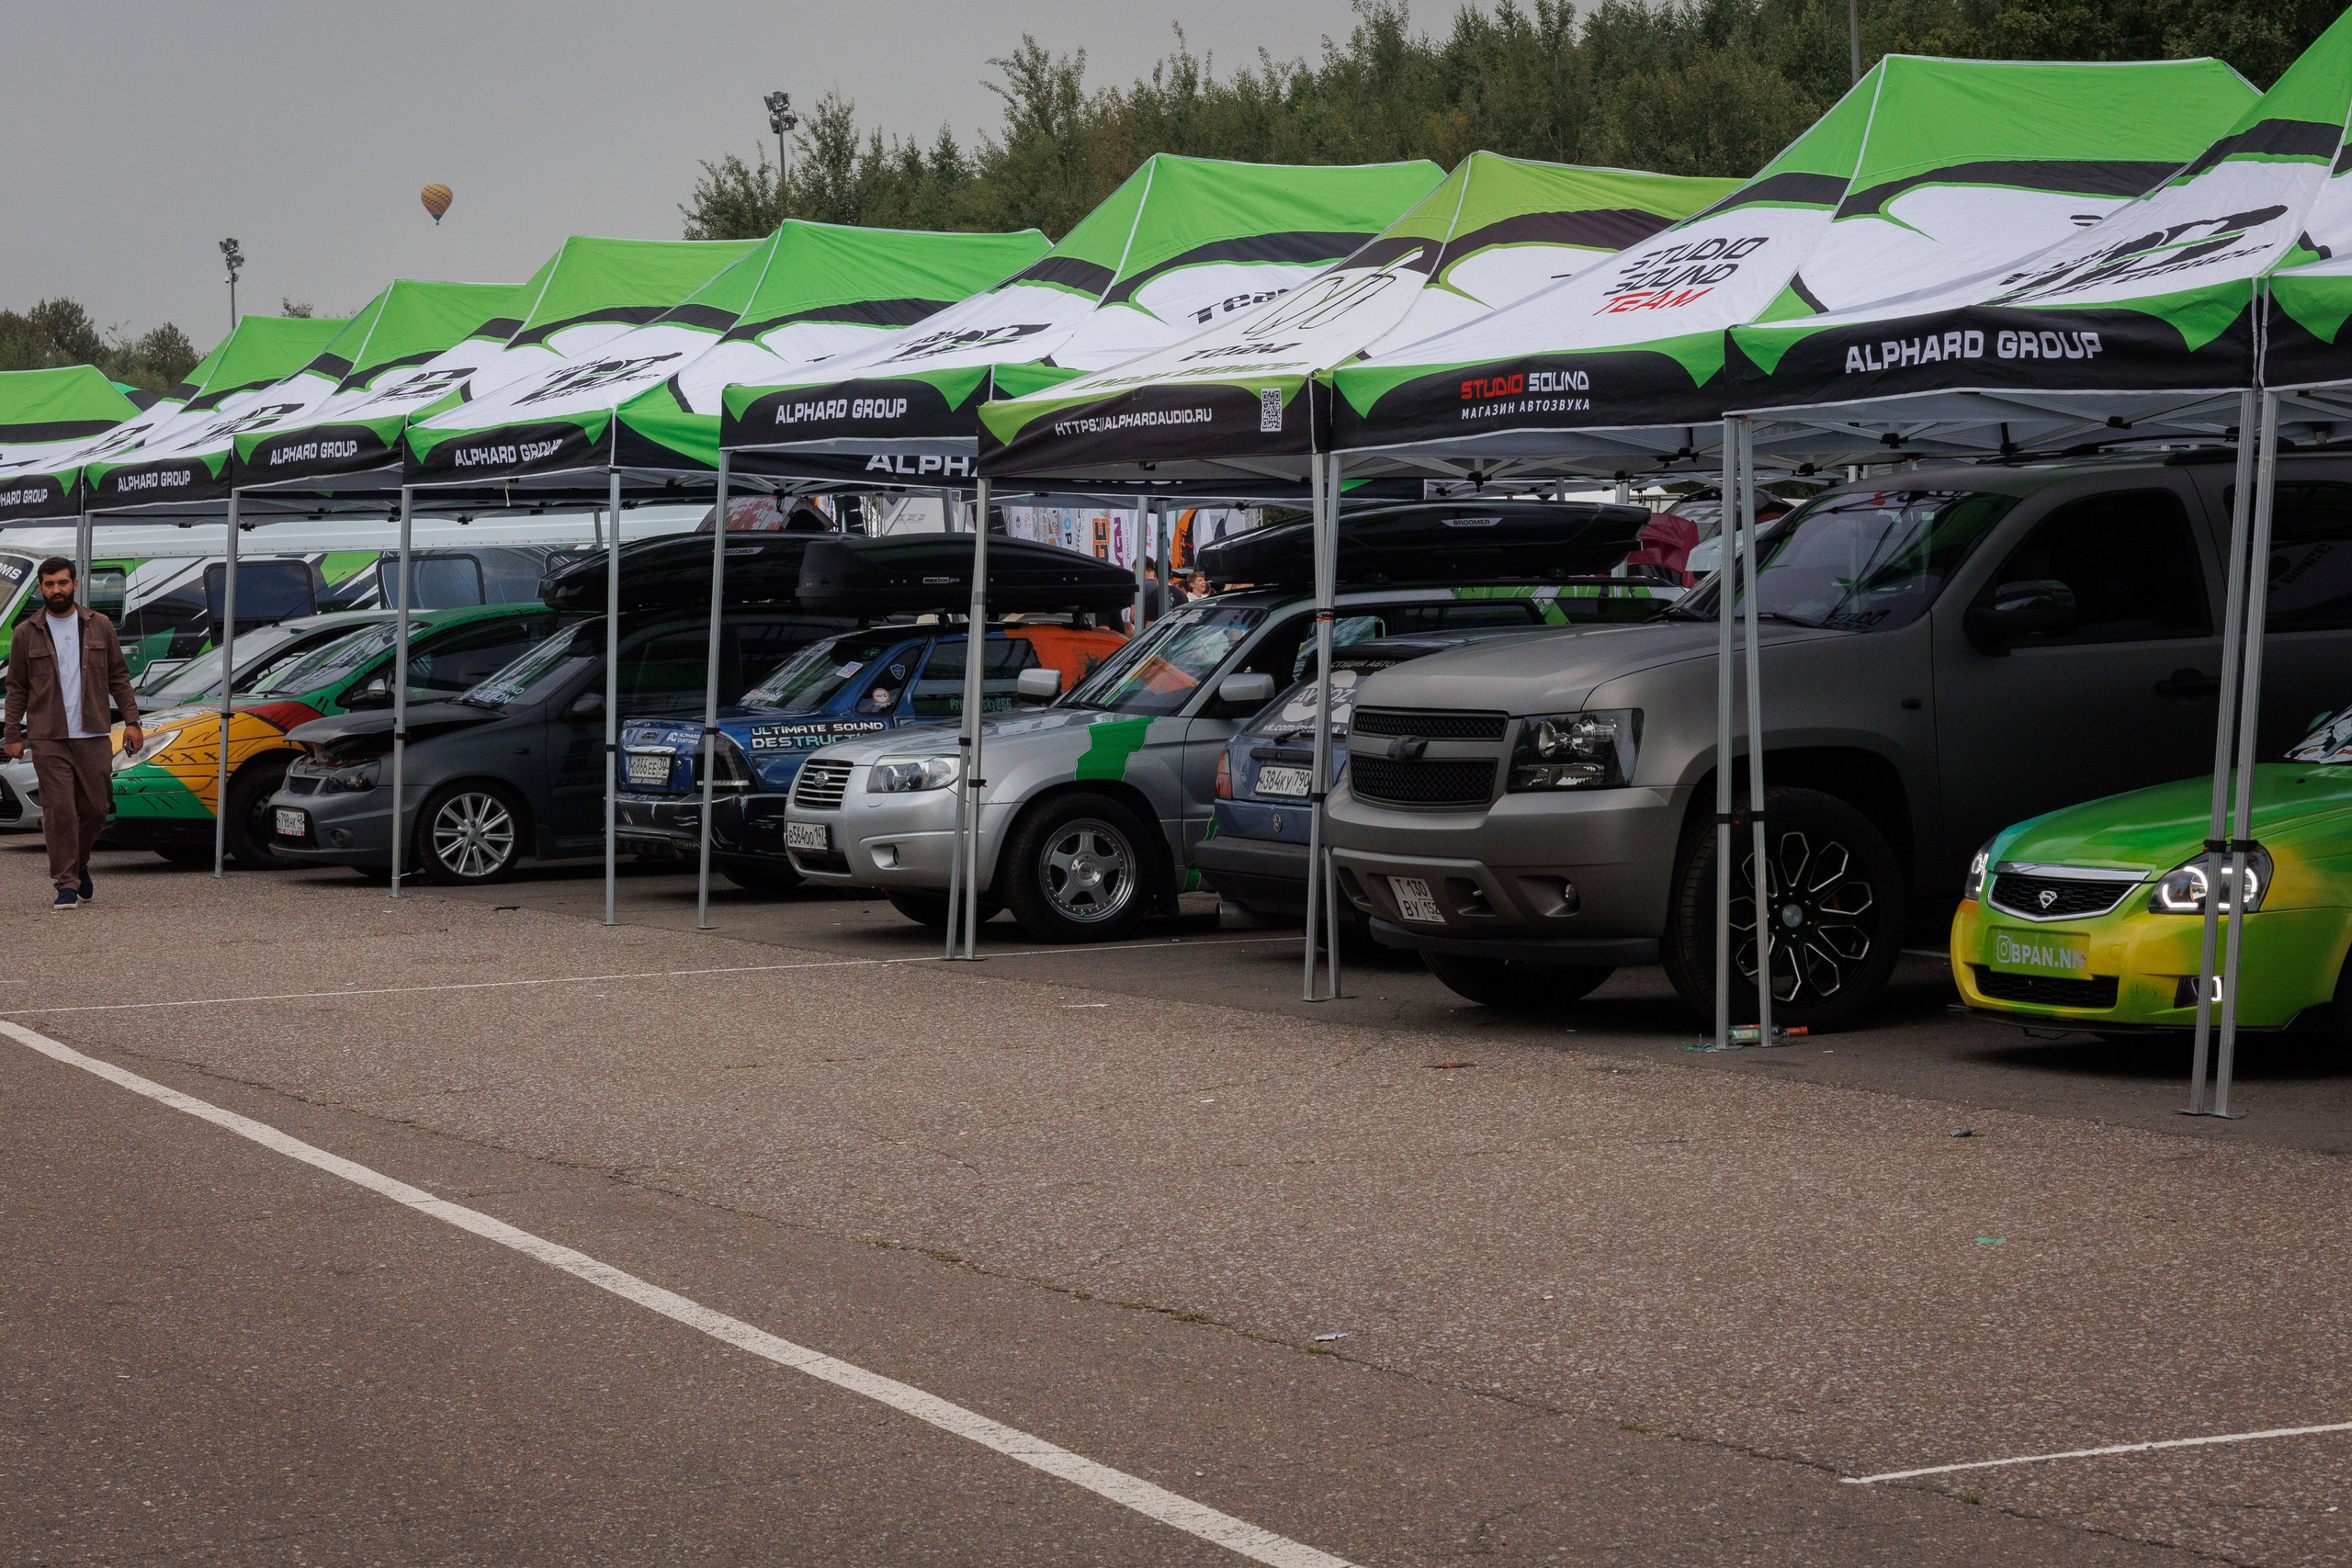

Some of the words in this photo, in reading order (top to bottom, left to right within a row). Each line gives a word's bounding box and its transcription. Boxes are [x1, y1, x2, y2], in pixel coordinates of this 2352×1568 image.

[1619, 237, 1770, 275] STUDIO
[1603, 263, 1740, 297] SOUND
[1592, 287, 1715, 316] TEAM
[1845, 331, 1984, 374] ALPHARD
[1996, 331, 2103, 359] GROUP
[1461, 373, 1524, 400] STUDIO
[1528, 370, 1589, 393] SOUND
[775, 398, 848, 424] ALPHARD
[852, 398, 908, 419] GROUP
[1055, 408, 1213, 436] HTTPS://ALPHARDAUDIO.RU
[1461, 401, 1515, 421] МАГАЗИН
[1520, 398, 1590, 412] АВТОЗВУКА
[270, 443, 318, 466] ALPHARD
[320, 440, 358, 458] GROUP
[455, 446, 516, 467] ALPHARD
[519, 439, 563, 462] GROUP
[865, 455, 978, 477] ALPH
[118, 471, 158, 492] ALPHARD
[160, 470, 191, 487] GROUP
[23, 489, 48, 504] GROUP
[752, 724, 827, 736] ULTIMATE
[832, 721, 884, 732] SOUND
[2011, 942, 2086, 970] BPAN.NN
